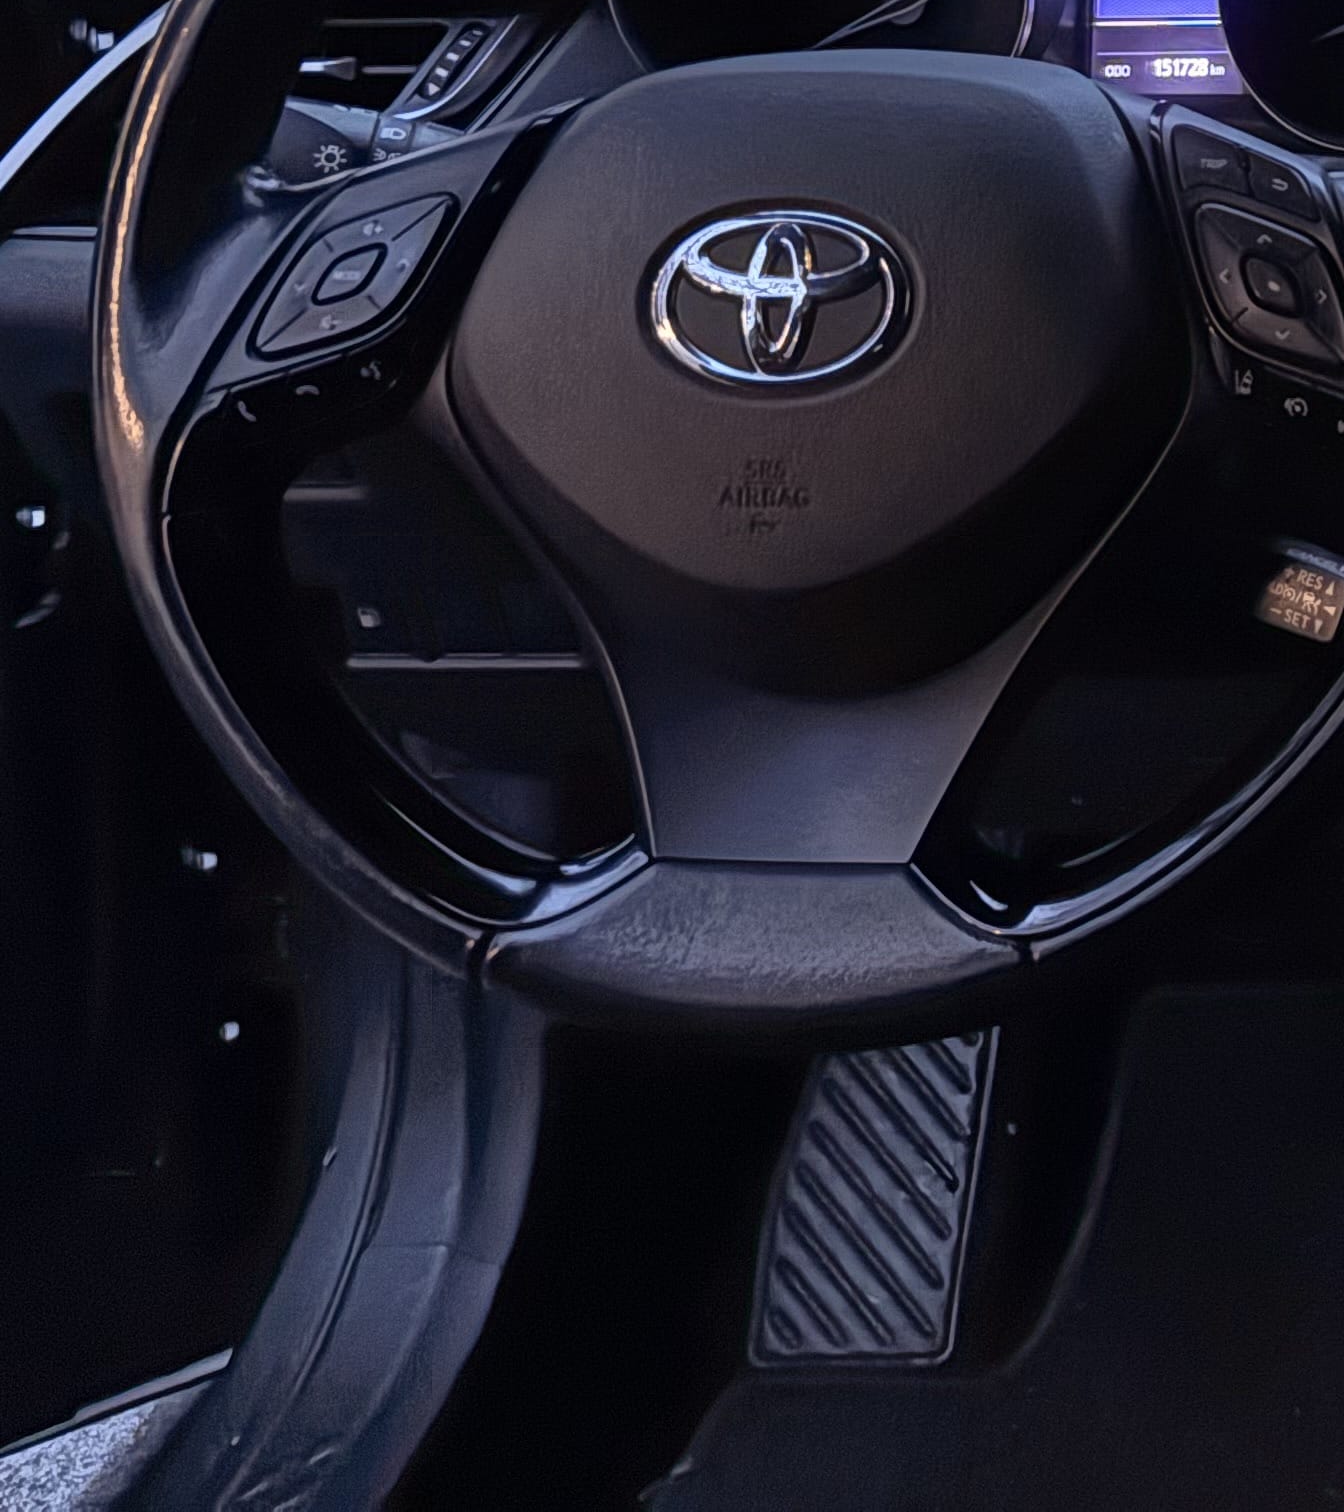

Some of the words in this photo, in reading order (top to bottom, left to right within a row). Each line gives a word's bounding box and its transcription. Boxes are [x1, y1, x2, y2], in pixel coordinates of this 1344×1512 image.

[1104, 65, 1131, 78] ODO
[1153, 58, 1209, 78] 151728
[1210, 64, 1225, 76] km
[719, 487, 810, 508] AIRBAG
[1297, 568, 1324, 591] RES
[1284, 609, 1311, 630] SET
